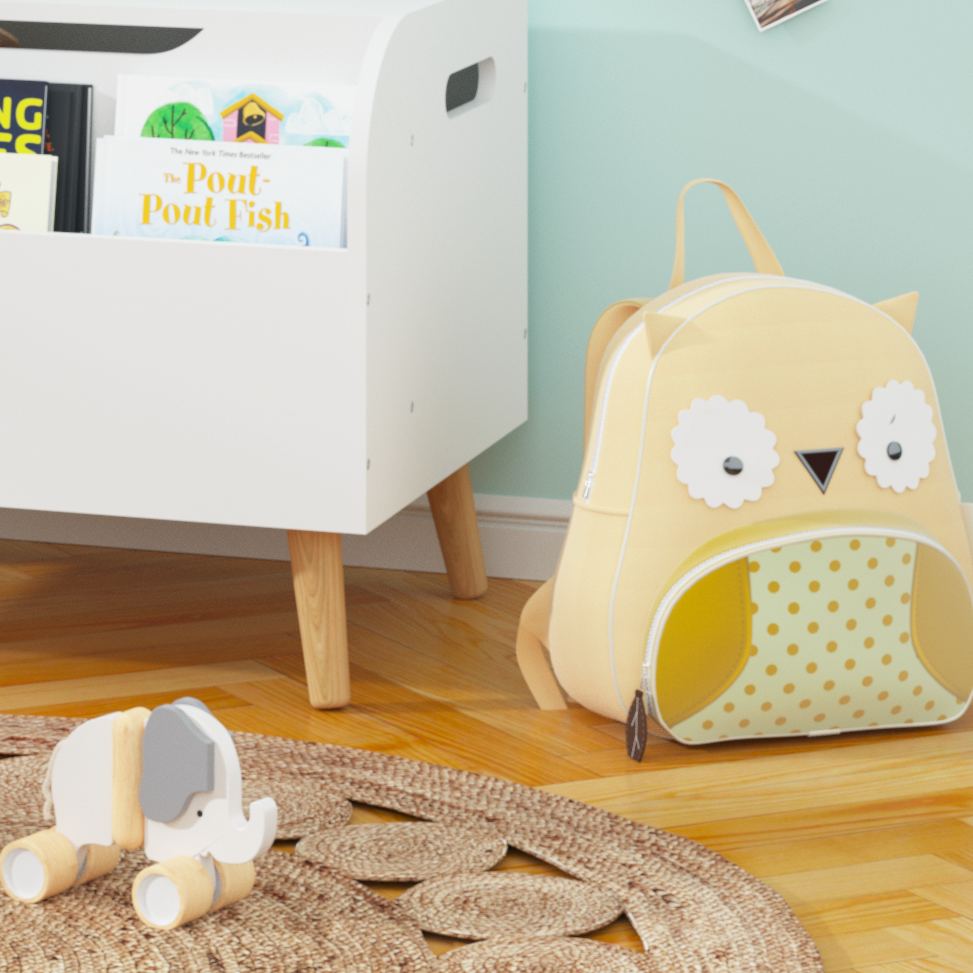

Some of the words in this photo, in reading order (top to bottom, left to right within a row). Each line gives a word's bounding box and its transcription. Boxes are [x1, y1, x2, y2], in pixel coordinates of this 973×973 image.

[170, 147, 183, 155] The
[185, 148, 199, 156] New
[202, 148, 216, 157] York
[219, 150, 238, 158] Times
[239, 152, 271, 160] Bestseller
[164, 173, 181, 183] The
[183, 162, 269, 196] Pout-
[139, 193, 217, 228] Pout
[225, 199, 290, 232] Fish
